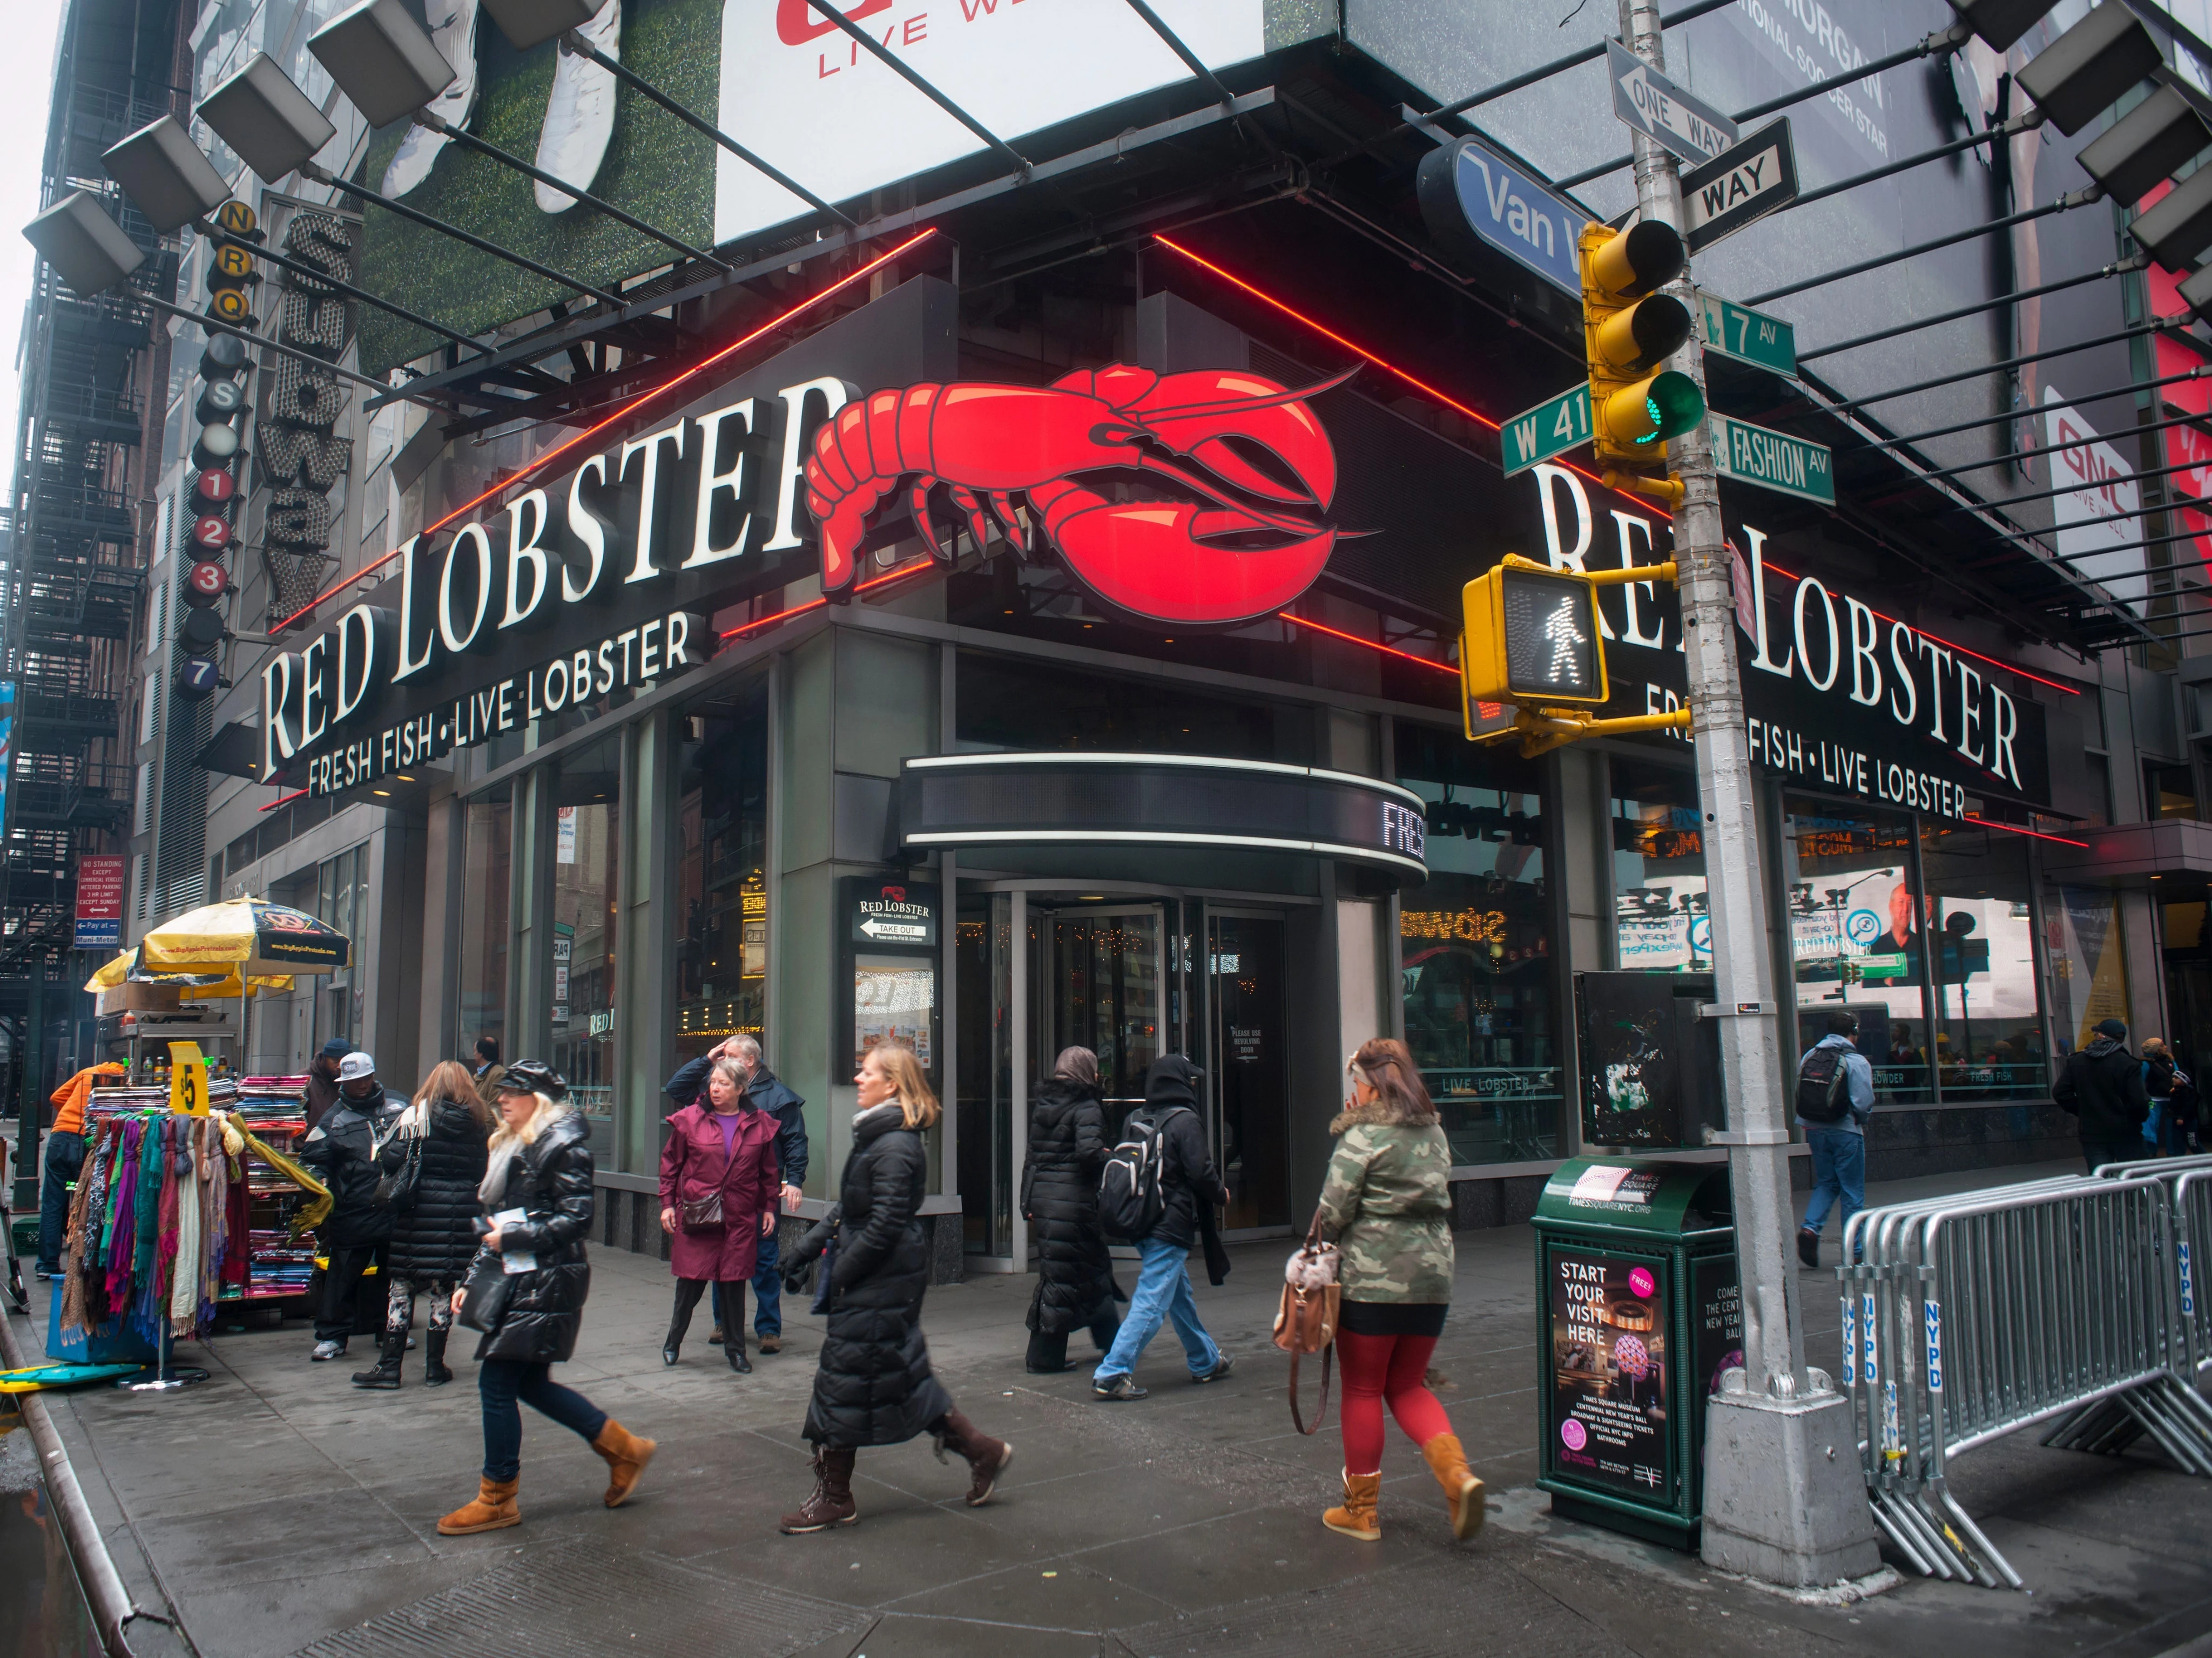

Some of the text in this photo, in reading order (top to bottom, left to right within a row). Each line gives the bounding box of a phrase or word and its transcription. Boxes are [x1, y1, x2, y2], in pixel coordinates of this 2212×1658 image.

[1634, 79, 1724, 156] ONE WAY
[1856, 107, 1889, 158] STAR
[1702, 155, 1765, 218] WAY
[1460, 148, 1554, 258] Van
[1719, 226, 1735, 236] DEPT
[1745, 193, 1795, 222] TRANSPORTATION
[219, 205, 249, 319] N R Q
[1731, 311, 1777, 354] 7 AV
[213, 383, 234, 407] S
[1514, 392, 1587, 462] W 41
[1733, 427, 1827, 488] FASHION AV
[2059, 417, 2132, 523] GNC
[199, 473, 222, 590] 1 2 3
[260, 376, 848, 786] RED LOBSTER
[1532, 463, 2022, 791] RE LOBSTER
[191, 661, 211, 684] 7
[308, 611, 687, 797] FRESH FISH LIVE LOBSTER
[1749, 717, 1965, 821] FISH LIVE LOBSTER
[859, 899, 929, 917] RED LOBSTER
[87, 922, 99, 930] Pay
[880, 925, 898, 933] TAKE
[1794, 933, 1872, 958] RED LOBSTER
[1443, 1077, 1529, 1092] LIVE LOBSTER
[1971, 1071, 2012, 1082] FRESH FISH
[1622, 1180, 1659, 1190] SQUARE
[1568, 1197, 1651, 1214] TIMESSQUARENYC.ORG
[1560, 1261, 1607, 1284] START
[1631, 1274, 1651, 1292] FREE!
[2177, 1244, 2192, 1312] NYPD
[1564, 1282, 1605, 1304] YOUR
[1717, 1286, 1738, 1300] COME
[1566, 1302, 1604, 1325] VISIT
[1705, 1302, 1720, 1316] THE
[1567, 1323, 1606, 1346] HERE
[1705, 1316, 1722, 1330] NEW
[1863, 1296, 1876, 1379] NYPD
[1925, 1302, 1941, 1388] NYPD
[1576, 1402, 1647, 1424] CENTENNIAL NEW YEAR'S BALL
[1582, 1394, 1641, 1414] TIMES SQUARE MUSEUM
[1570, 1409, 1596, 1421] BROADWAY
[1601, 1416, 1633, 1429] SIGHTSEEING
[1633, 1423, 1654, 1435] TICKETS
[1589, 1423, 1634, 1439] OFFICIAL NYC INFO
[1596, 1433, 1627, 1447] BATHROOMS
